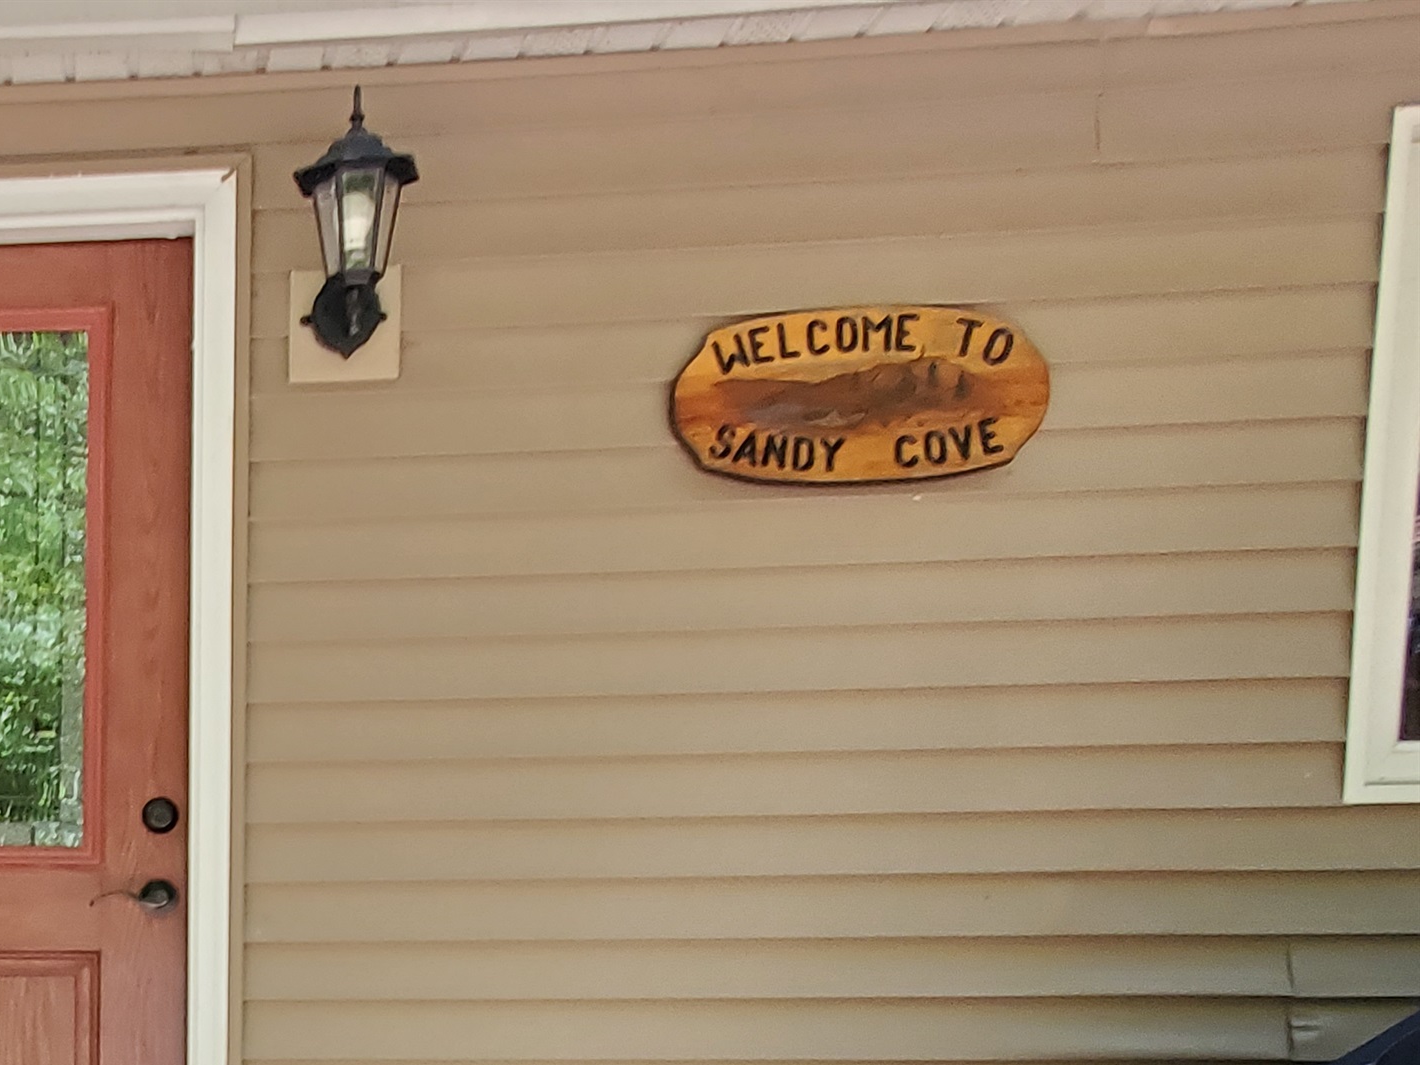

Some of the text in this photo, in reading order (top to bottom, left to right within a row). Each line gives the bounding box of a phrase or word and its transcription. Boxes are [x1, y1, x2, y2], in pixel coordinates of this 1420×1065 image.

[711, 314, 1014, 374] WELCOME TO
[709, 418, 1004, 472] SANDY COVE
